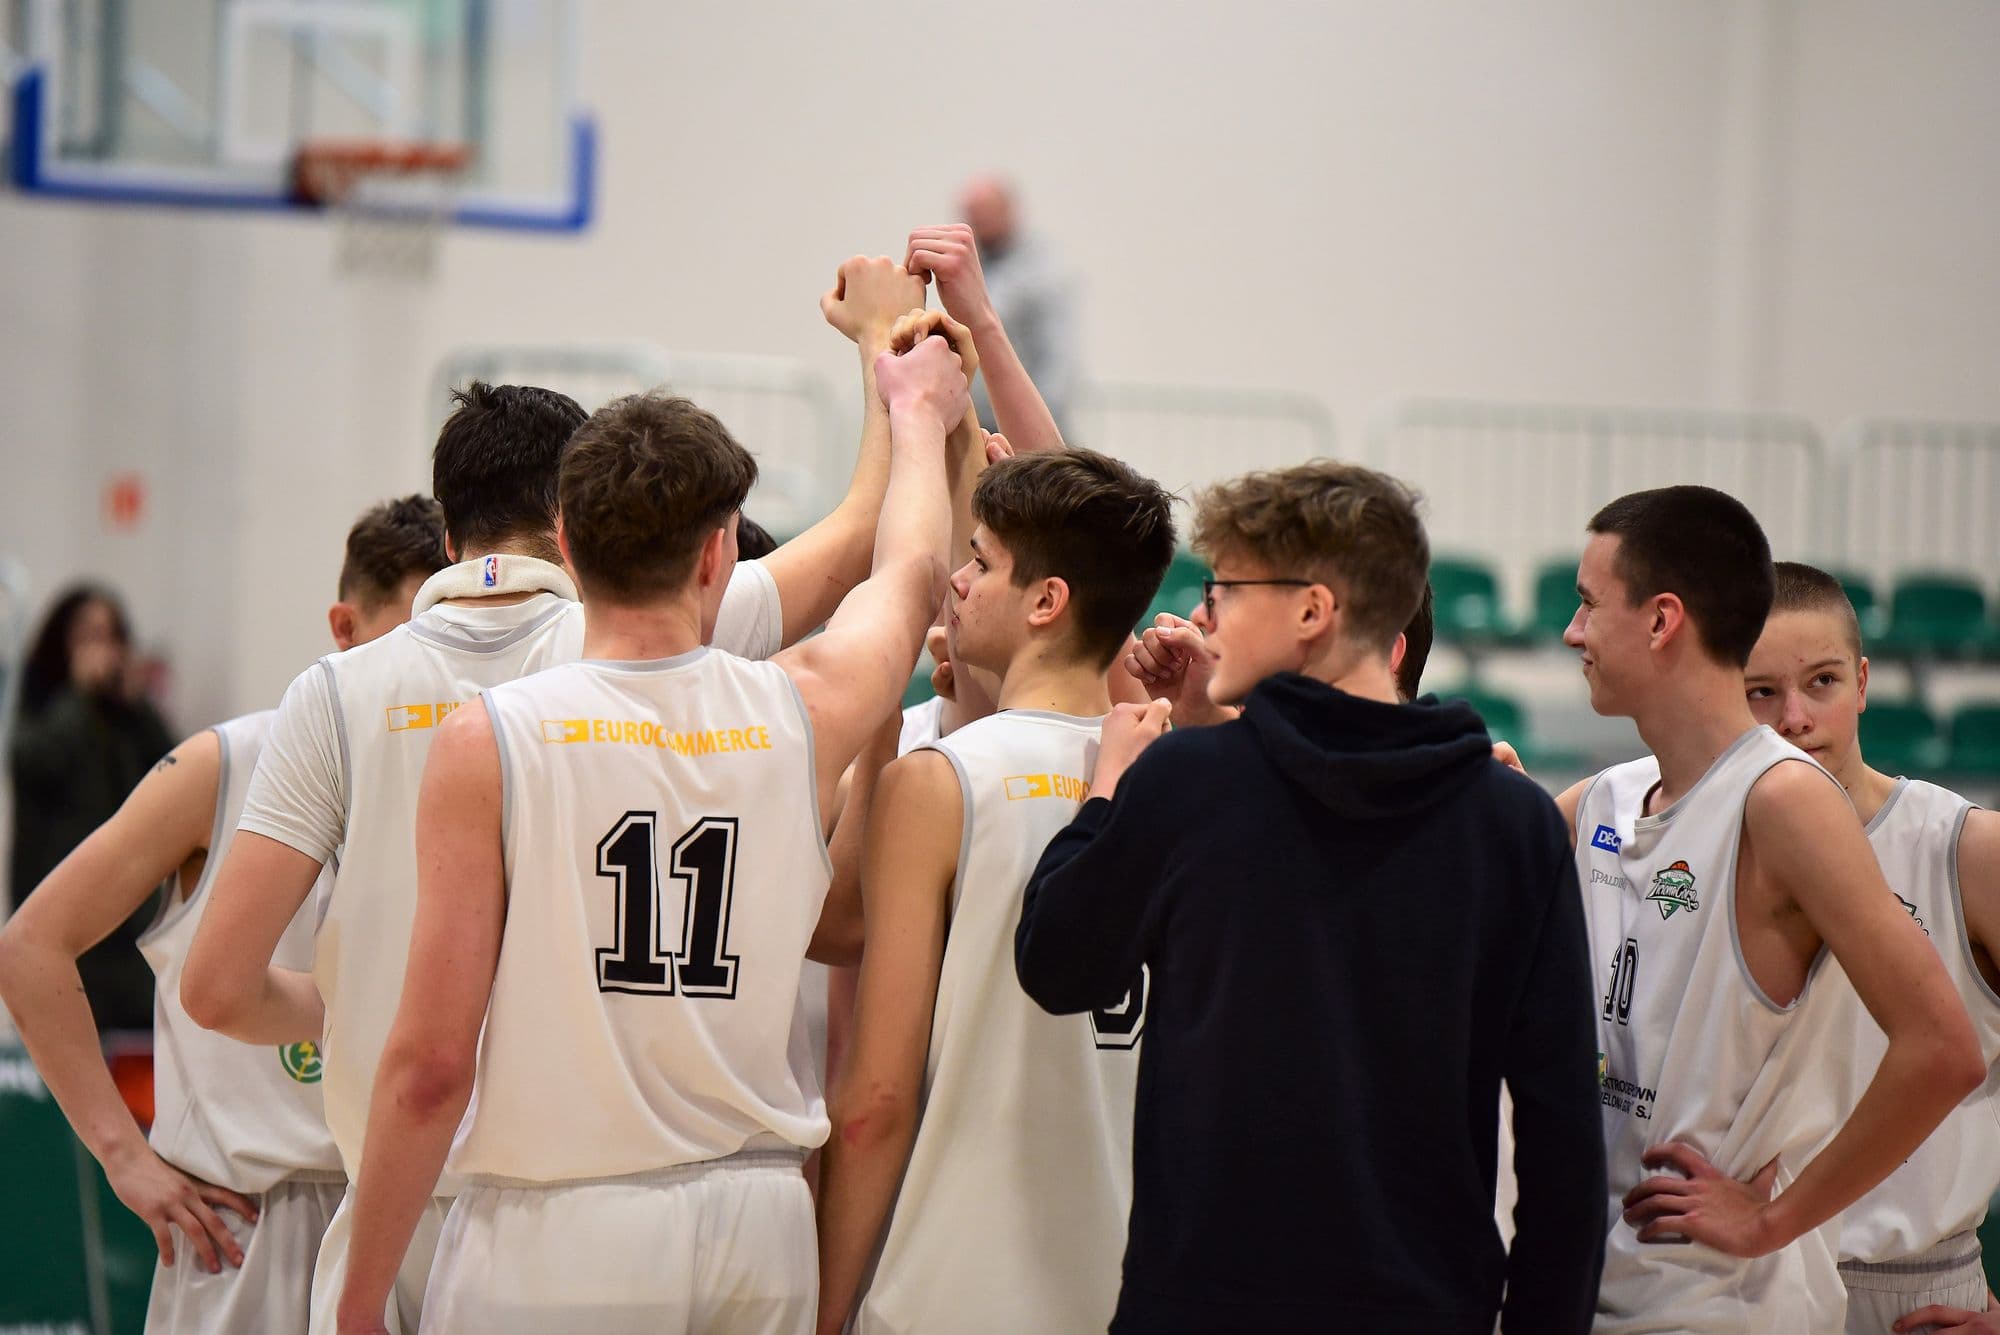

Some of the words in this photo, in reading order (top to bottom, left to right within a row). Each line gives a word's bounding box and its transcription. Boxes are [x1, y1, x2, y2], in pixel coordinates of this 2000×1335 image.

[593, 719, 772, 757] EUROCOMMERCE
[595, 811, 740, 1000] 11
[1603, 937, 1639, 1026] 10
